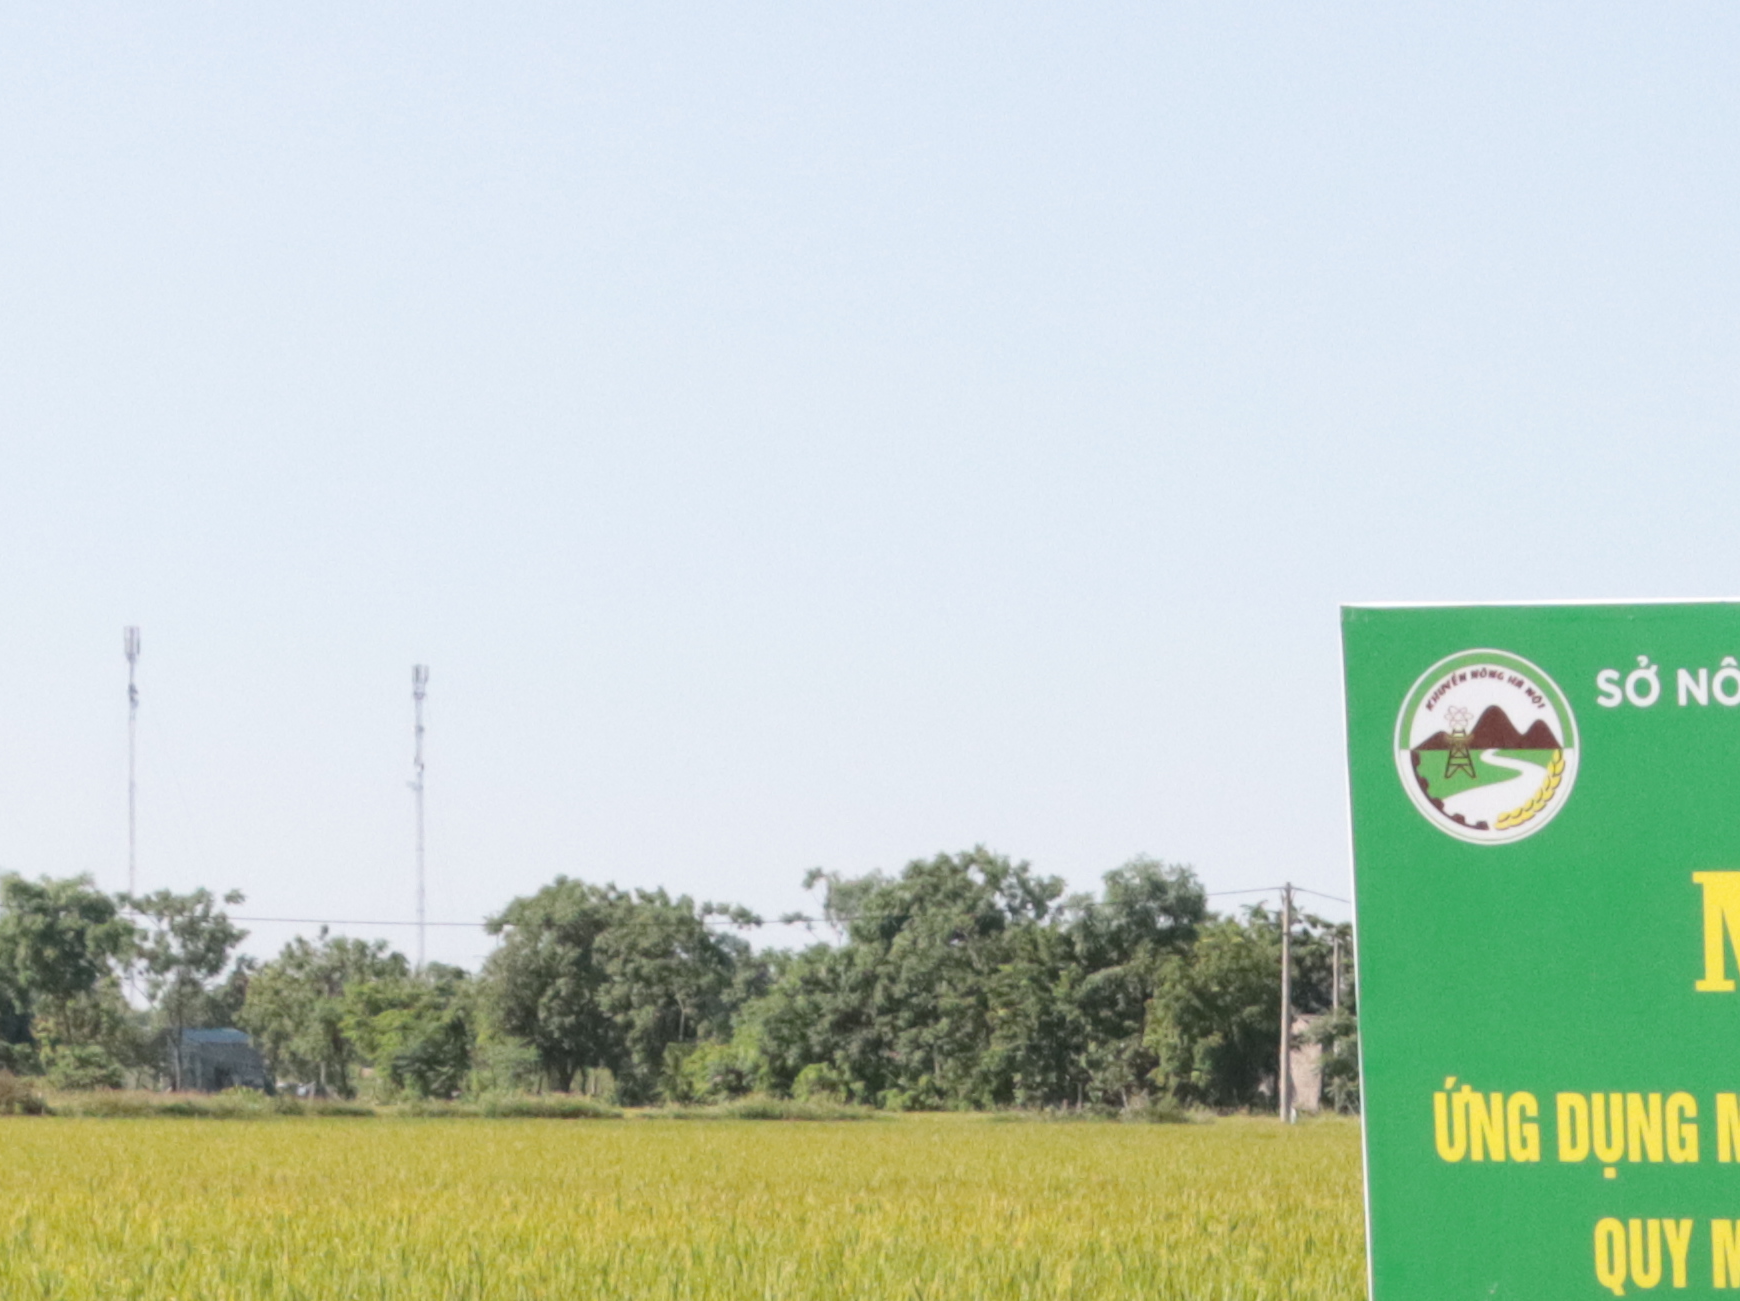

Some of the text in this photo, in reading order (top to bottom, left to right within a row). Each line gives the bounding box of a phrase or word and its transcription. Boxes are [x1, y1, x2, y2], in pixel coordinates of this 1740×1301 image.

[1596, 656, 1661, 707] SỞ
[1434, 1076, 1541, 1162] ỨNG
[1556, 1091, 1699, 1179] DỤNG
[1594, 1217, 1693, 1296] QUY
